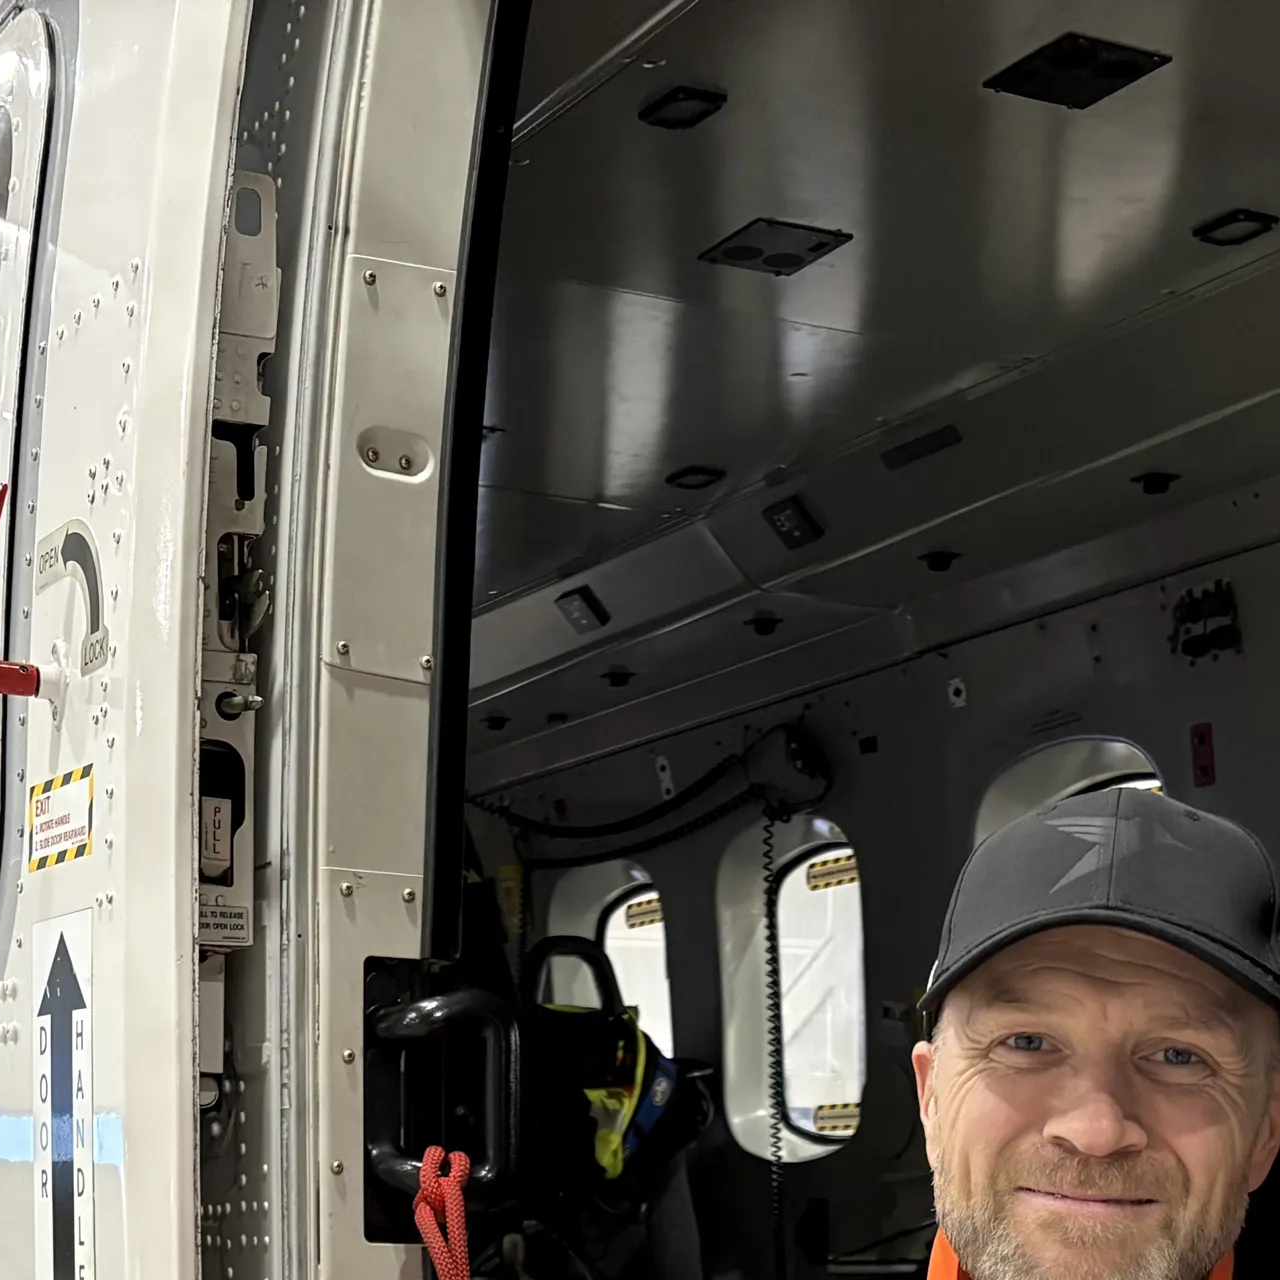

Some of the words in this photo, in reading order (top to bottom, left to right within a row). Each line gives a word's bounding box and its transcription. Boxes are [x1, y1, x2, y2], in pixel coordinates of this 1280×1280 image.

[38, 544, 60, 575] OPEN
[84, 635, 106, 666] LOCK
[35, 795, 51, 817] EXIT
[54, 813, 71, 827] HANDLE
[213, 806, 221, 854] PULL
[51, 834, 63, 847] DOOR
[219, 911, 244, 920] RELEASE
[230, 923, 245, 931] LOCK
[39, 1025, 49, 1199] DOOR
